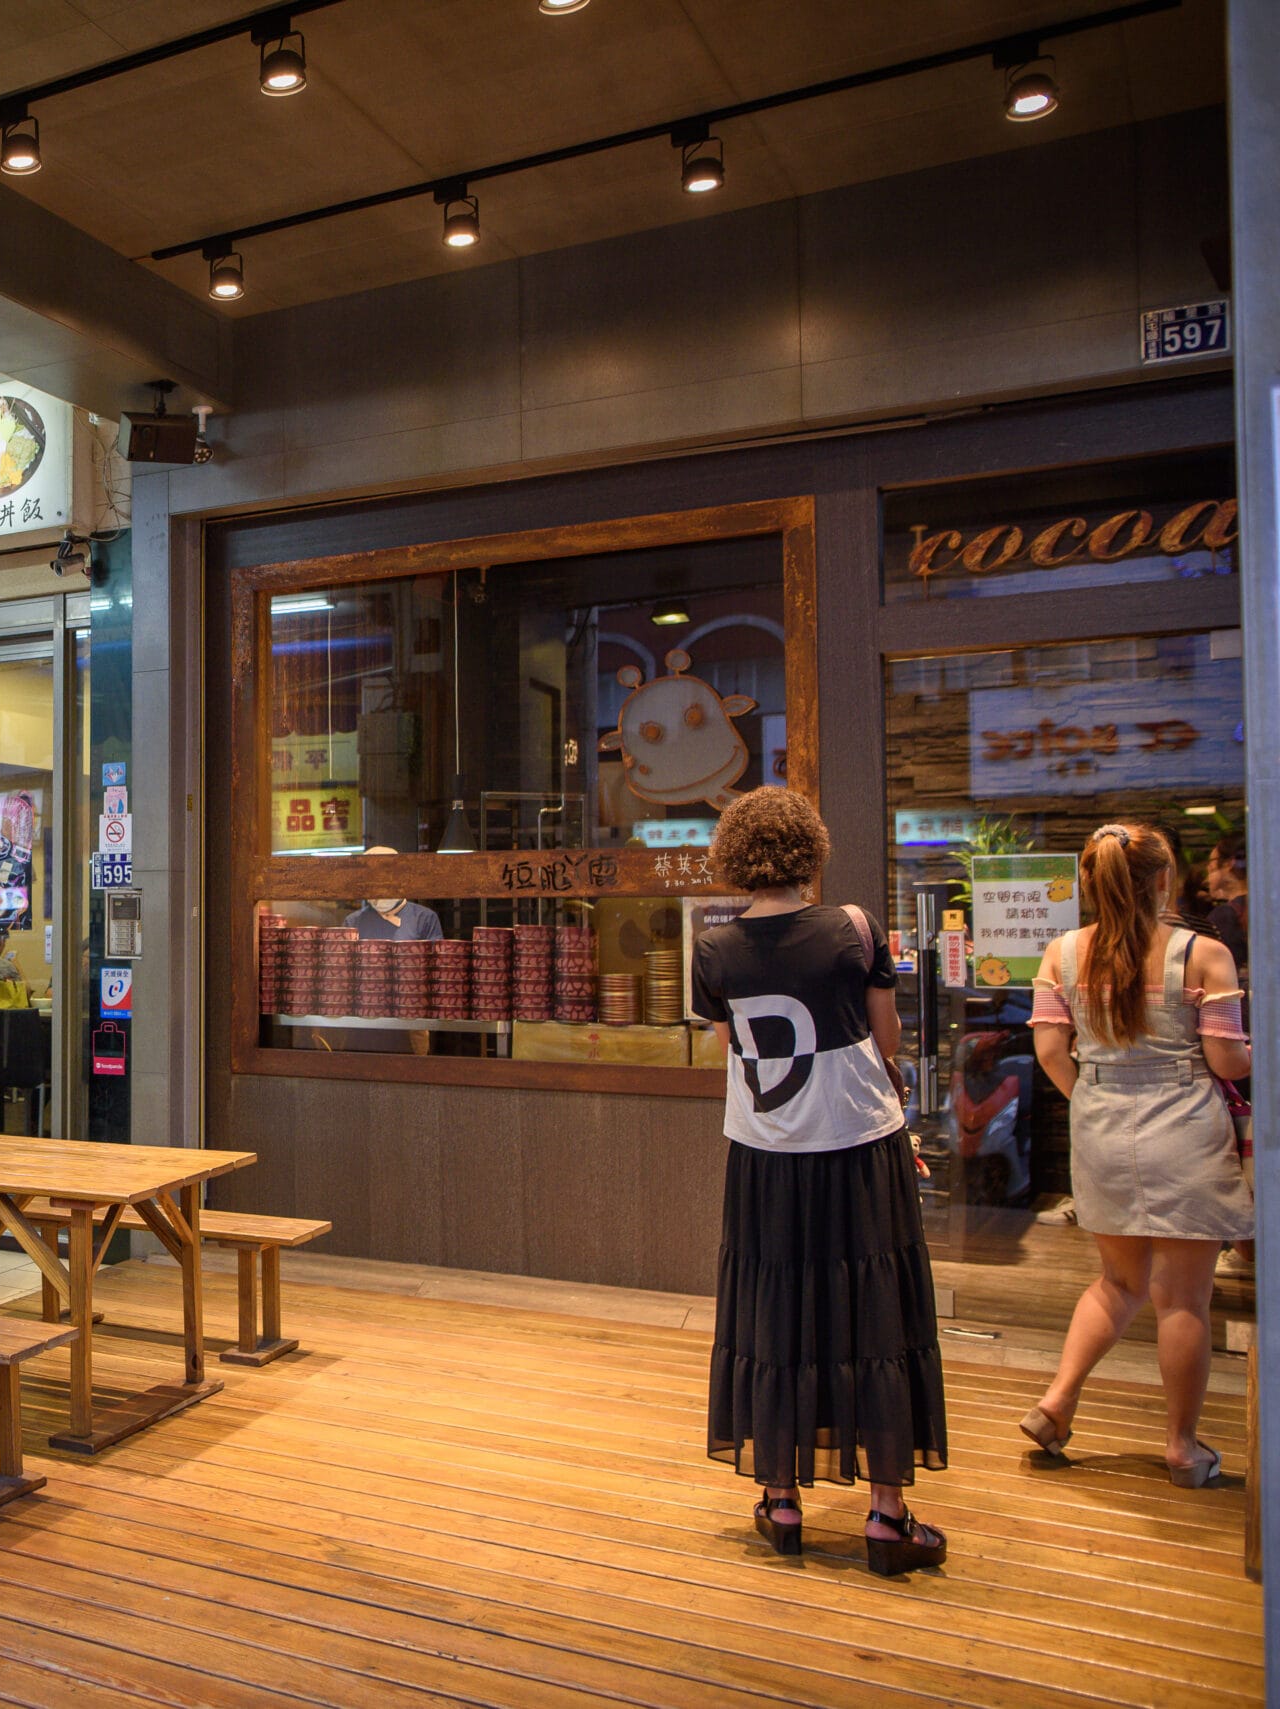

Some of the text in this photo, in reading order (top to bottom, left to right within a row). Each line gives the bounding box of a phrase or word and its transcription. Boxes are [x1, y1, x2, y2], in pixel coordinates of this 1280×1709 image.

[1163, 318, 1223, 353] 597
[103, 864, 132, 885] 595
[654, 852, 714, 878] 蔡英文
